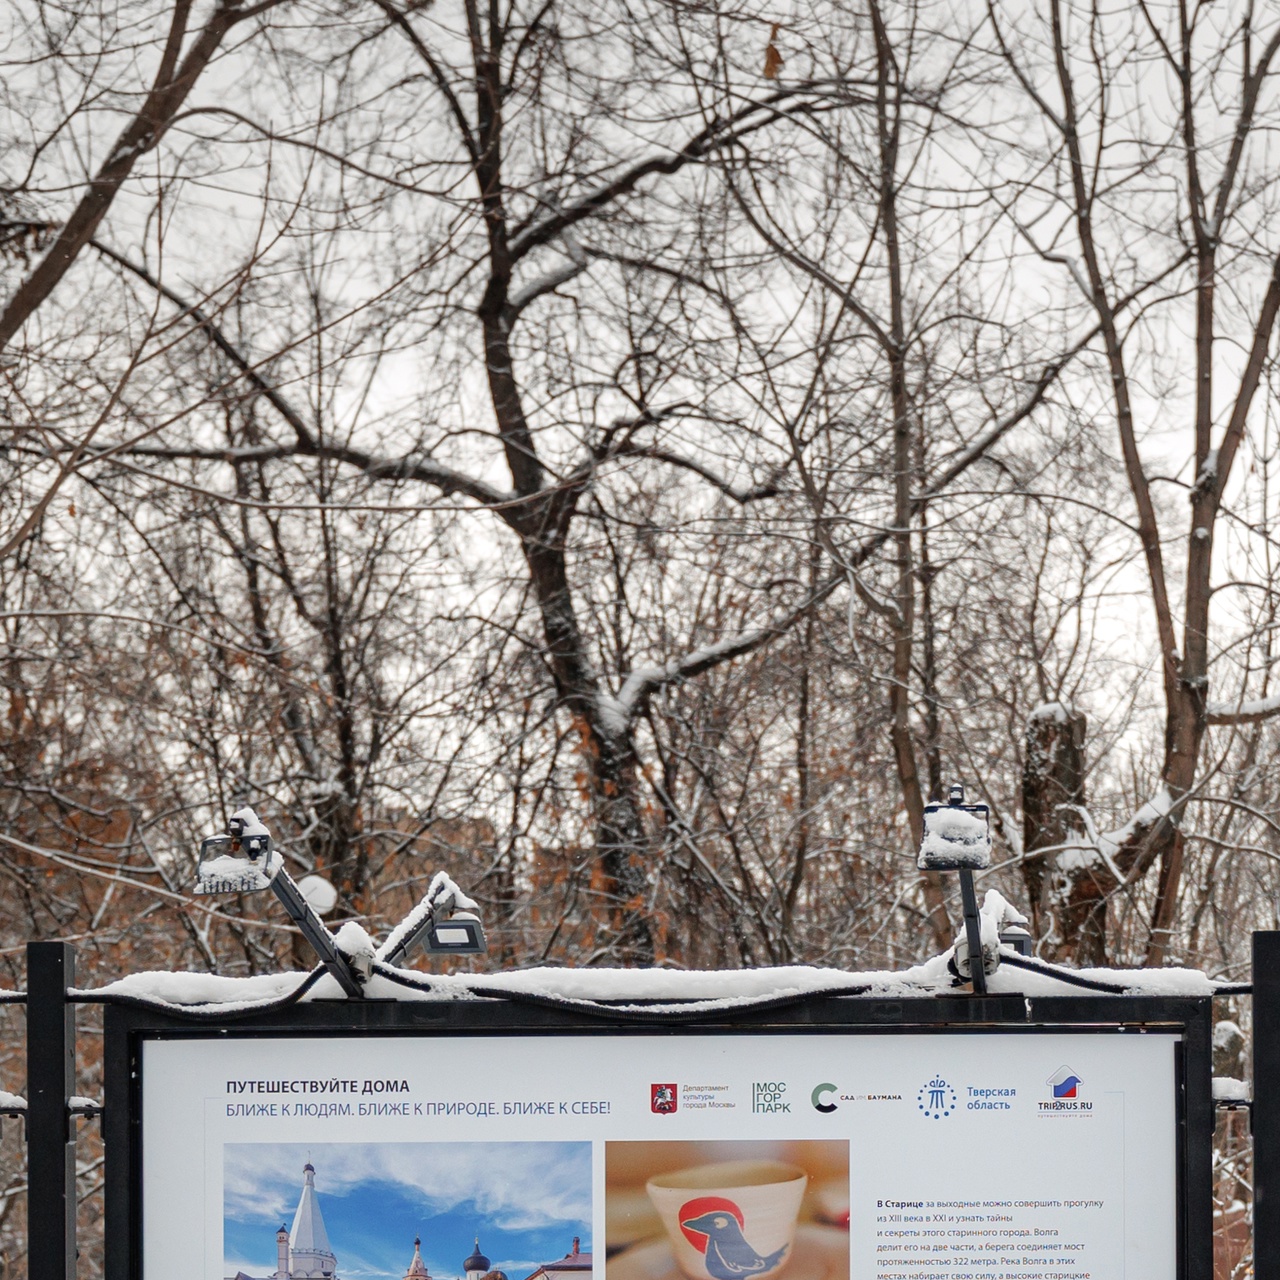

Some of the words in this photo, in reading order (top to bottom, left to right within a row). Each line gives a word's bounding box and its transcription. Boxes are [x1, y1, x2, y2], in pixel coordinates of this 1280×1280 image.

[226, 1078, 358, 1093] ПУТЕШЕСТВУЙТЕ
[362, 1080, 410, 1095] ДОМА
[757, 1083, 786, 1092] МОС
[757, 1093, 781, 1102] ГОР
[967, 1087, 1016, 1098] Тверская
[757, 1104, 791, 1112] ПАРК
[967, 1100, 1010, 1109] область
[226, 1104, 278, 1116] БЛИЖЕ
[282, 1104, 290, 1116] К
[293, 1103, 354, 1118] ЛЮДЯМ.
[358, 1103, 410, 1116] БЛИЖЕ
[414, 1103, 422, 1115] К
[427, 1102, 499, 1117] ПРИРОДЕ.
[504, 1102, 555, 1115] БЛИЖЕ
[559, 1102, 568, 1114] К
[572, 1102, 610, 1114] СЕБЕ!
[885, 1200, 924, 1210] Старице
[1014, 1201, 1062, 1209] совершить
[956, 1216, 984, 1224] узнать
[986, 1214, 1013, 1222] тайны
[947, 1230, 998, 1238] старинного
[1034, 1228, 1058, 1236] Волга
[985, 1242, 1014, 1252] берега
[970, 1259, 999, 1267] метра.
[1001, 1257, 1020, 1265] Река
[1022, 1257, 1047, 1265] Волга
[1044, 1273, 1090, 1280] старицкие
